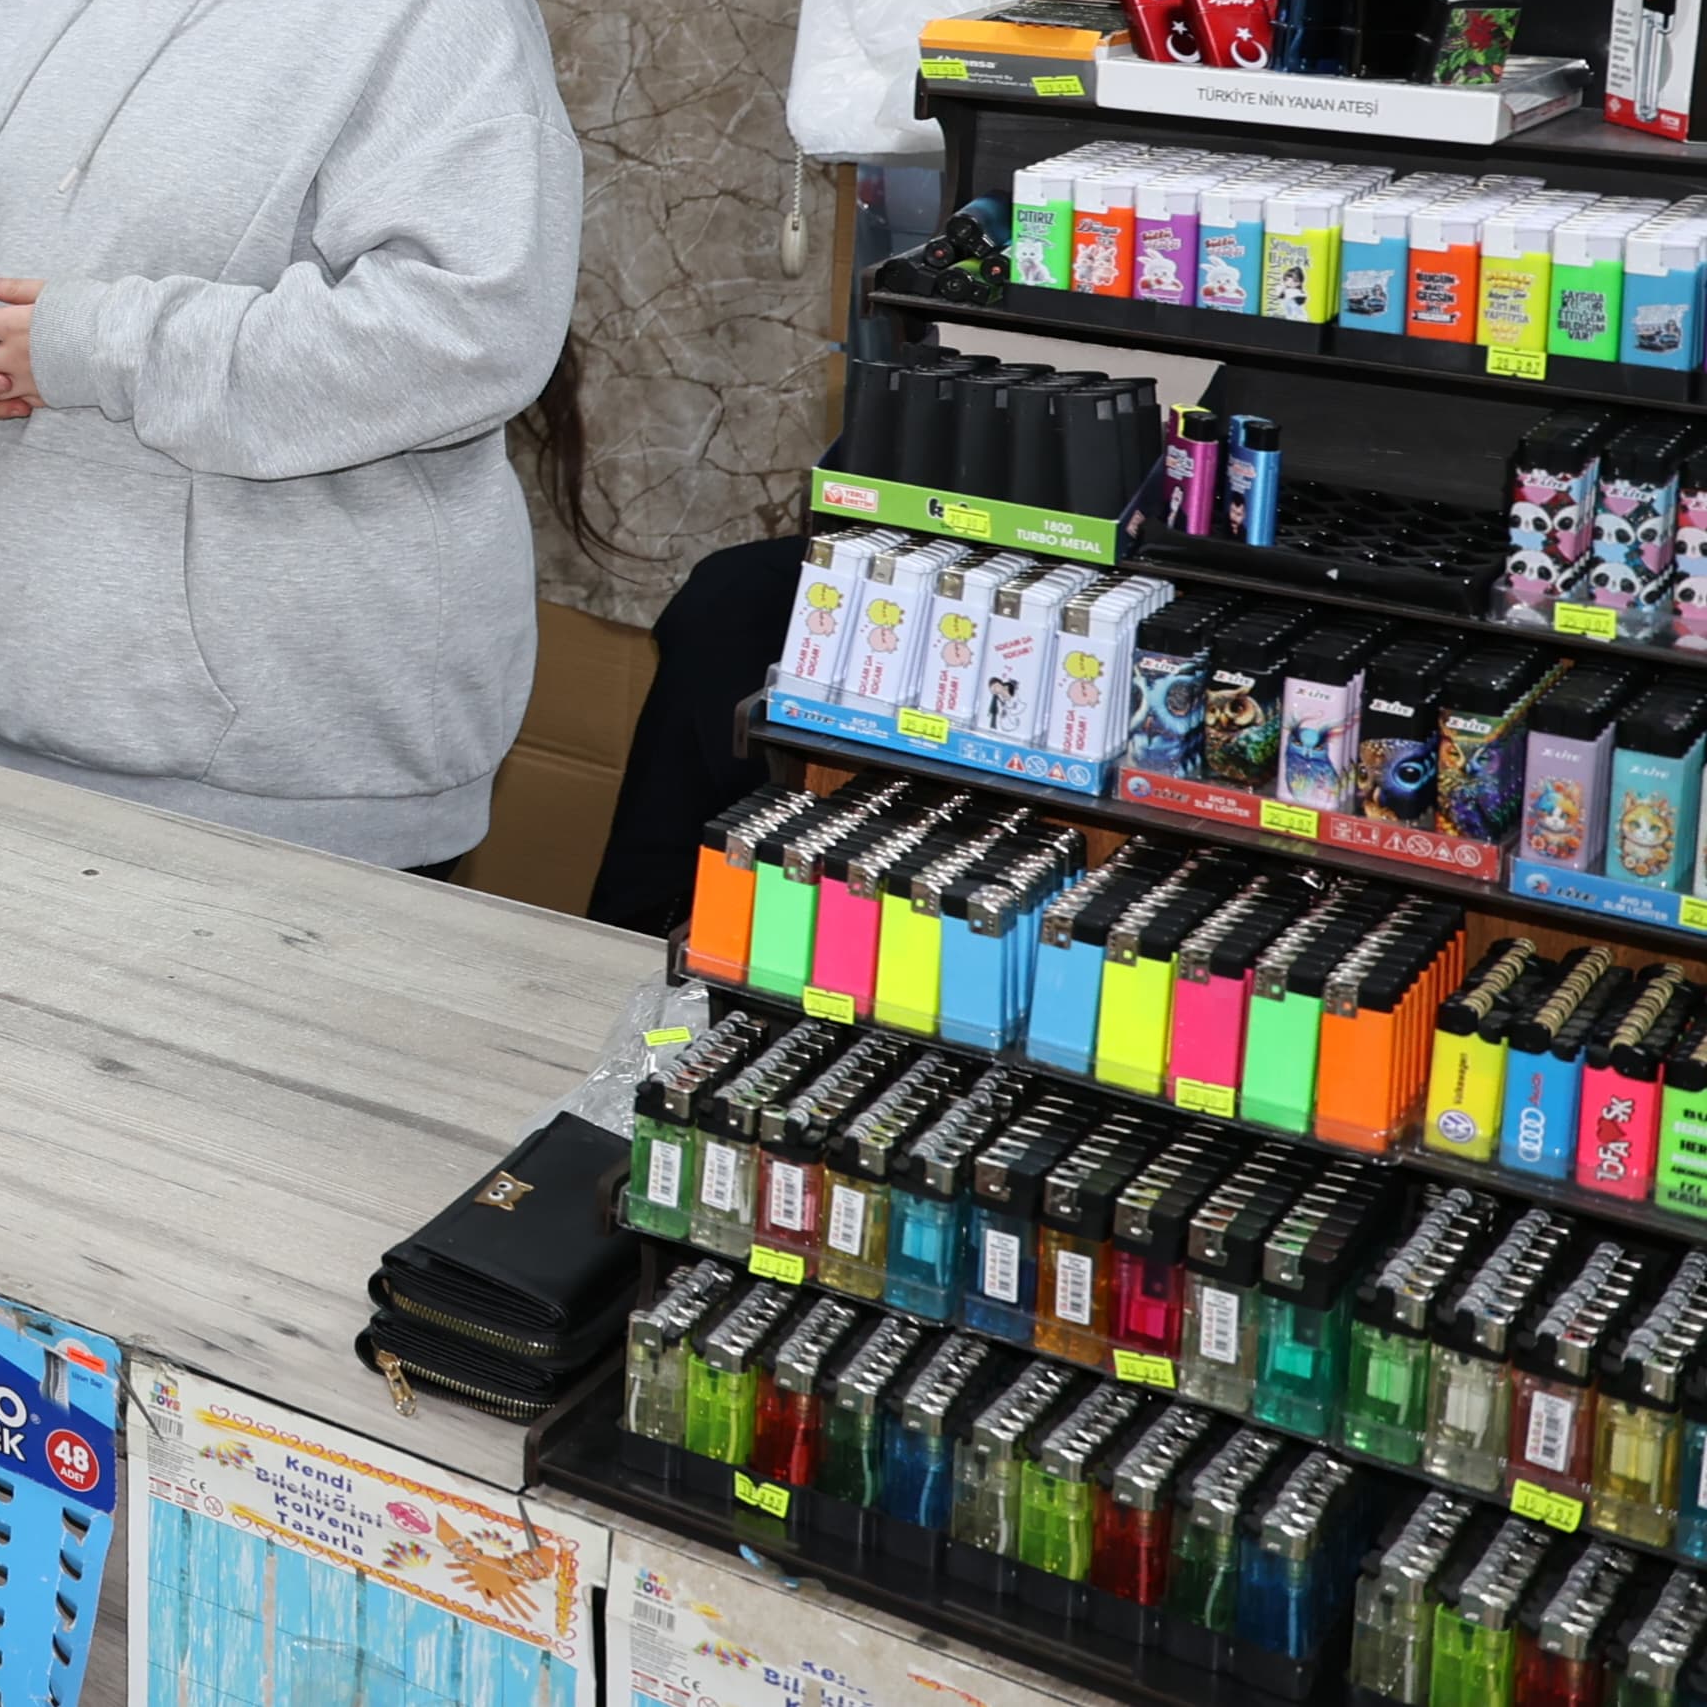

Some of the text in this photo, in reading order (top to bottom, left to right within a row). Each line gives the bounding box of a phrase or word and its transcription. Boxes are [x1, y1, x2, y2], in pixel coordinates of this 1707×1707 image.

[1197, 85, 1379, 117] TÜRKİYE NİN YANAN ATEŞİ
[1016, 529, 1101, 555] TURBO METAL
[1043, 519, 1073, 535] 1800
[54, 1439, 90, 1479] 48
[286, 1454, 353, 1494] Kendi
[60, 1466, 86, 1486] ADET
[275, 1510, 365, 1557] Tasarla
